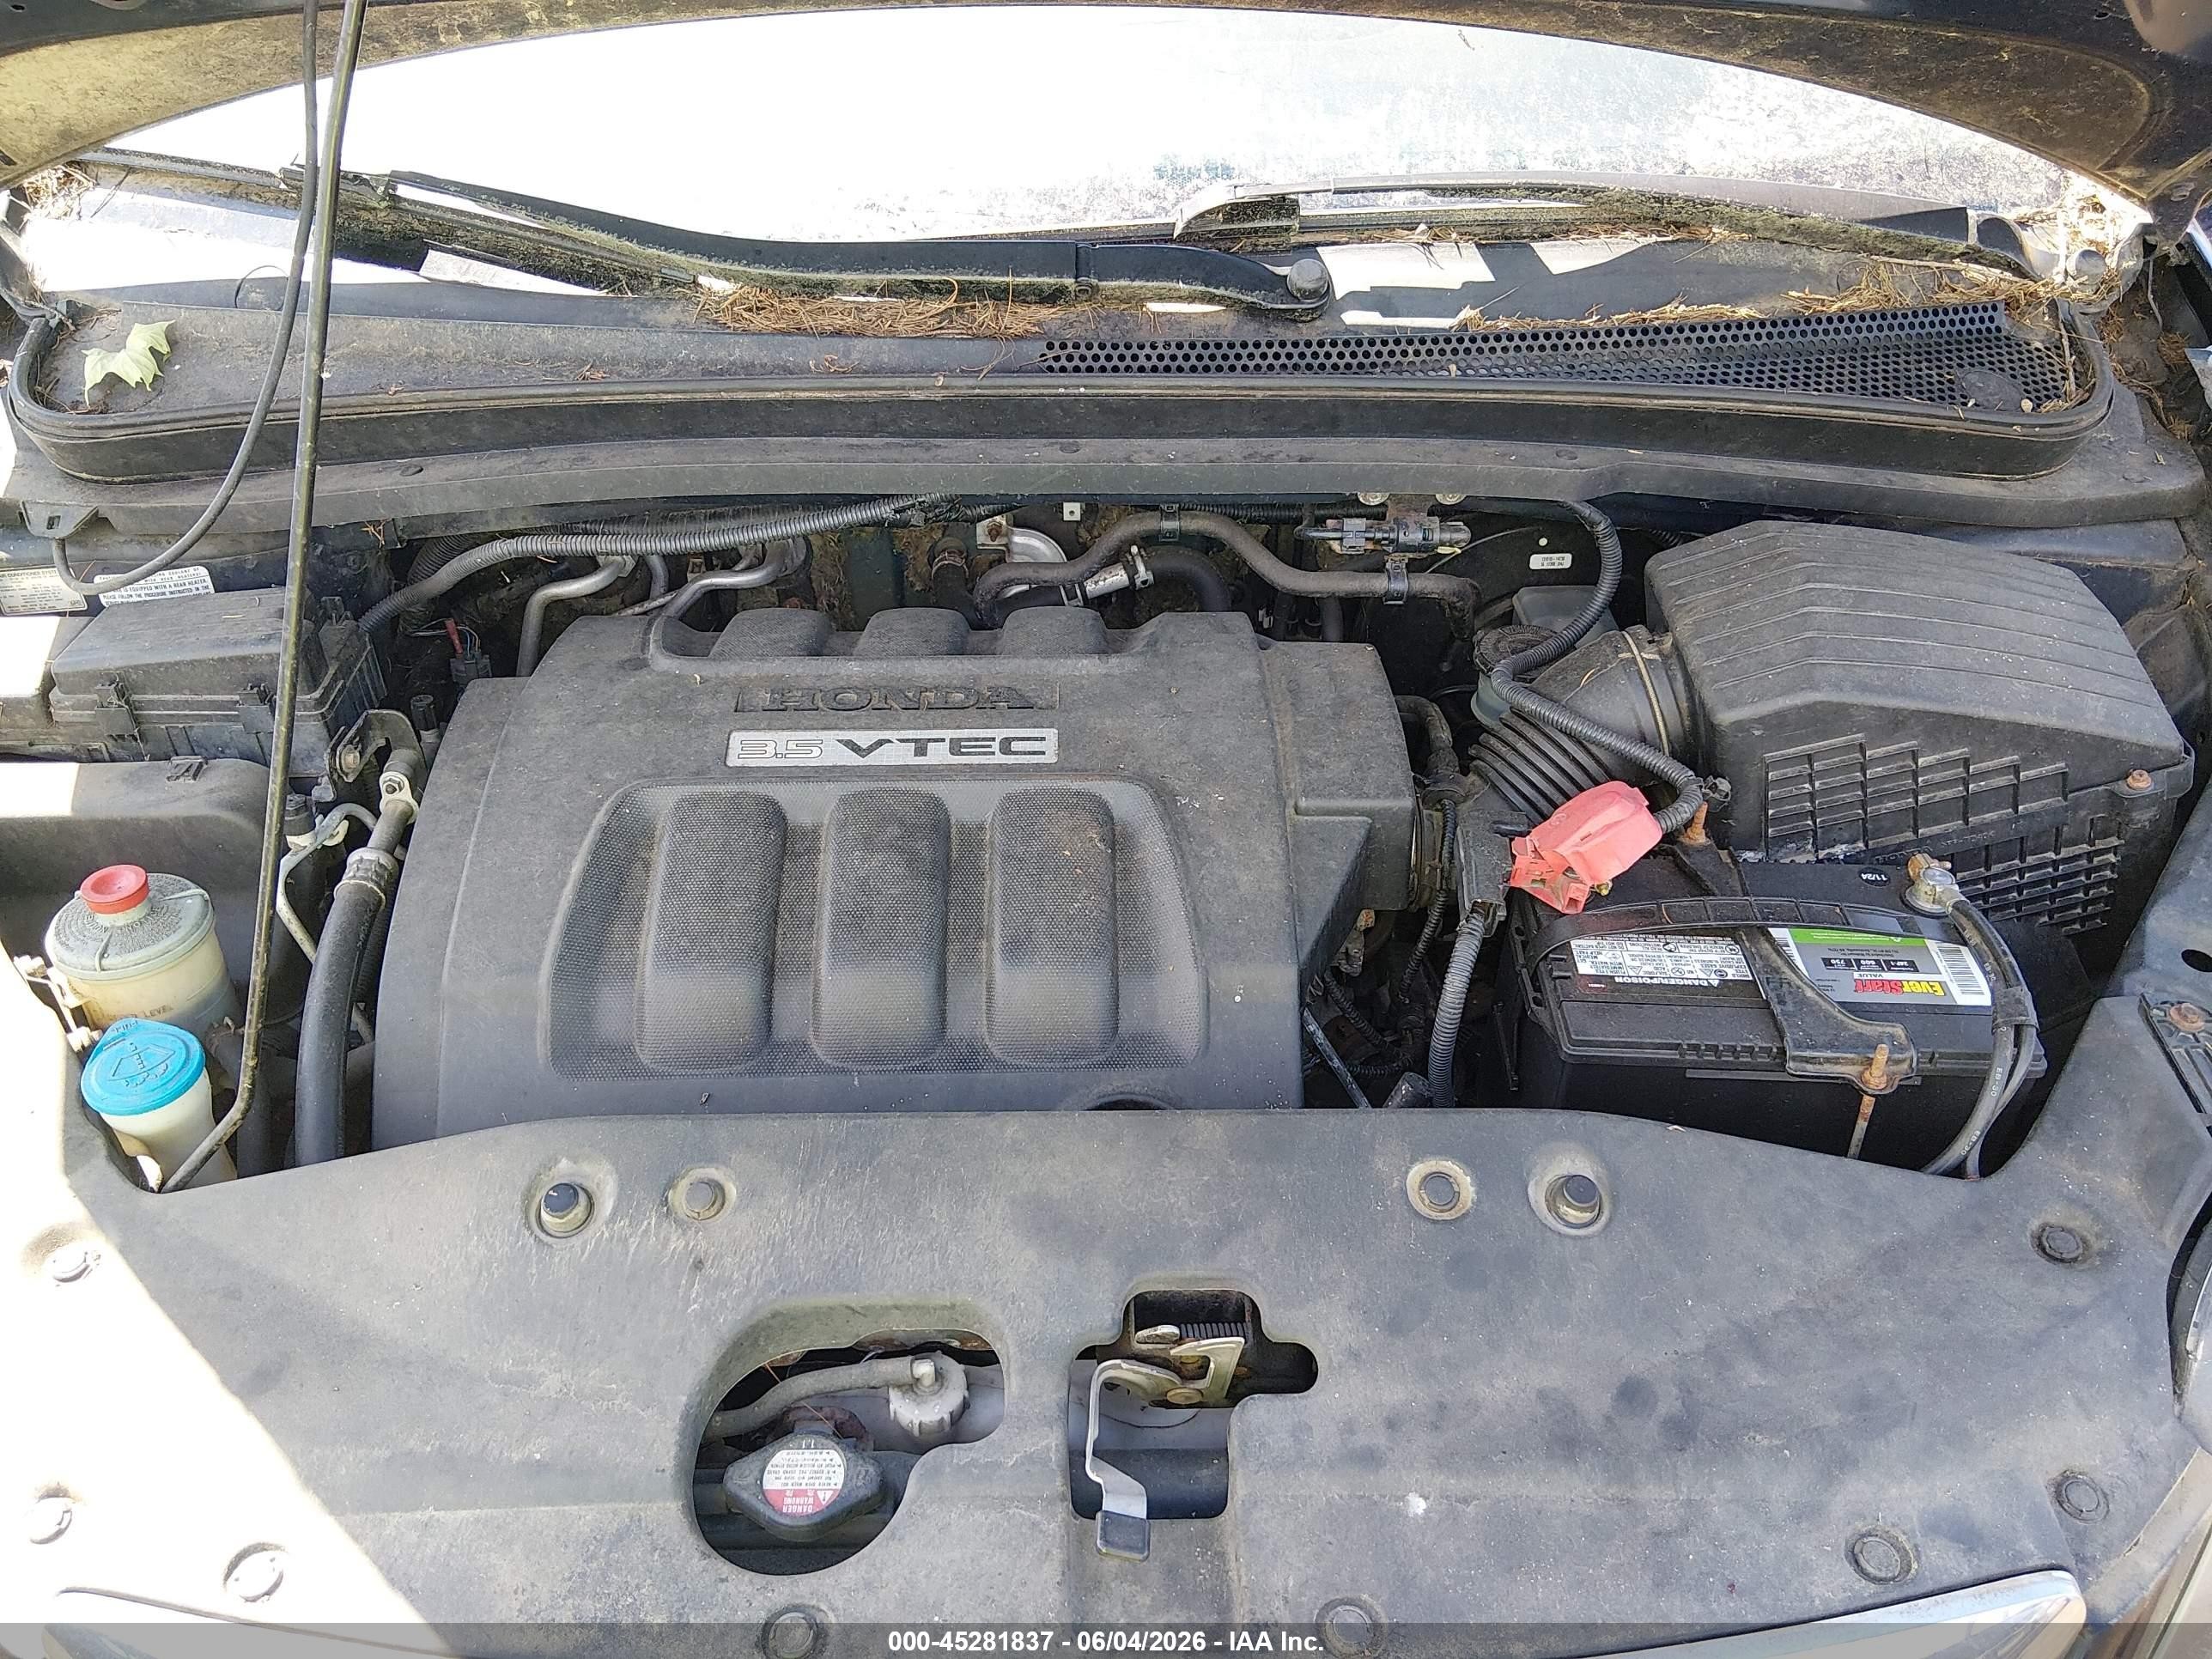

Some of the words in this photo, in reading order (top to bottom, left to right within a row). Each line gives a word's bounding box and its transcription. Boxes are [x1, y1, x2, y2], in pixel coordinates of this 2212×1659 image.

[762, 685, 1036, 712] HONDA
[737, 738, 823, 759] 3.5
[835, 737, 1046, 758] VTEC
[1614, 976, 1709, 987] DANGER/POISON
[1854, 979, 1946, 997] EverStart
